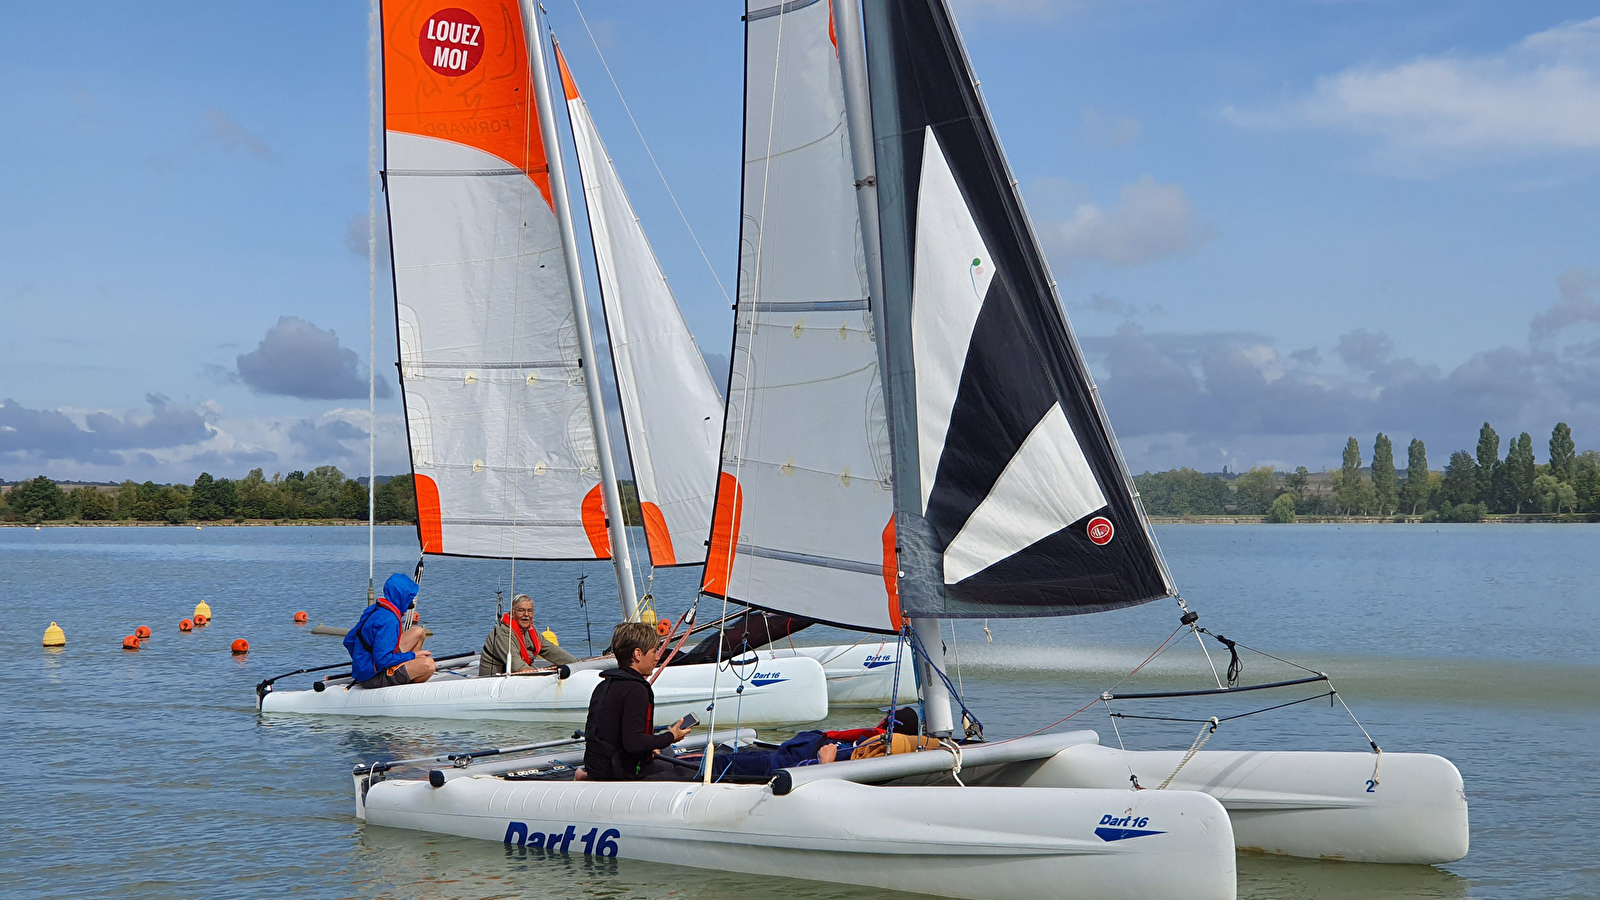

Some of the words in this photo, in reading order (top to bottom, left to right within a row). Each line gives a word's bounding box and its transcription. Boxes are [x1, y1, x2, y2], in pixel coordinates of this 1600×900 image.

[427, 19, 481, 47] LOUEZ
[433, 46, 468, 71] MOI
[1365, 779, 1376, 793] 2
[1099, 814, 1132, 827] Dart
[1132, 816, 1150, 828] 16
[504, 821, 577, 852] Dart
[580, 827, 621, 858] 16
